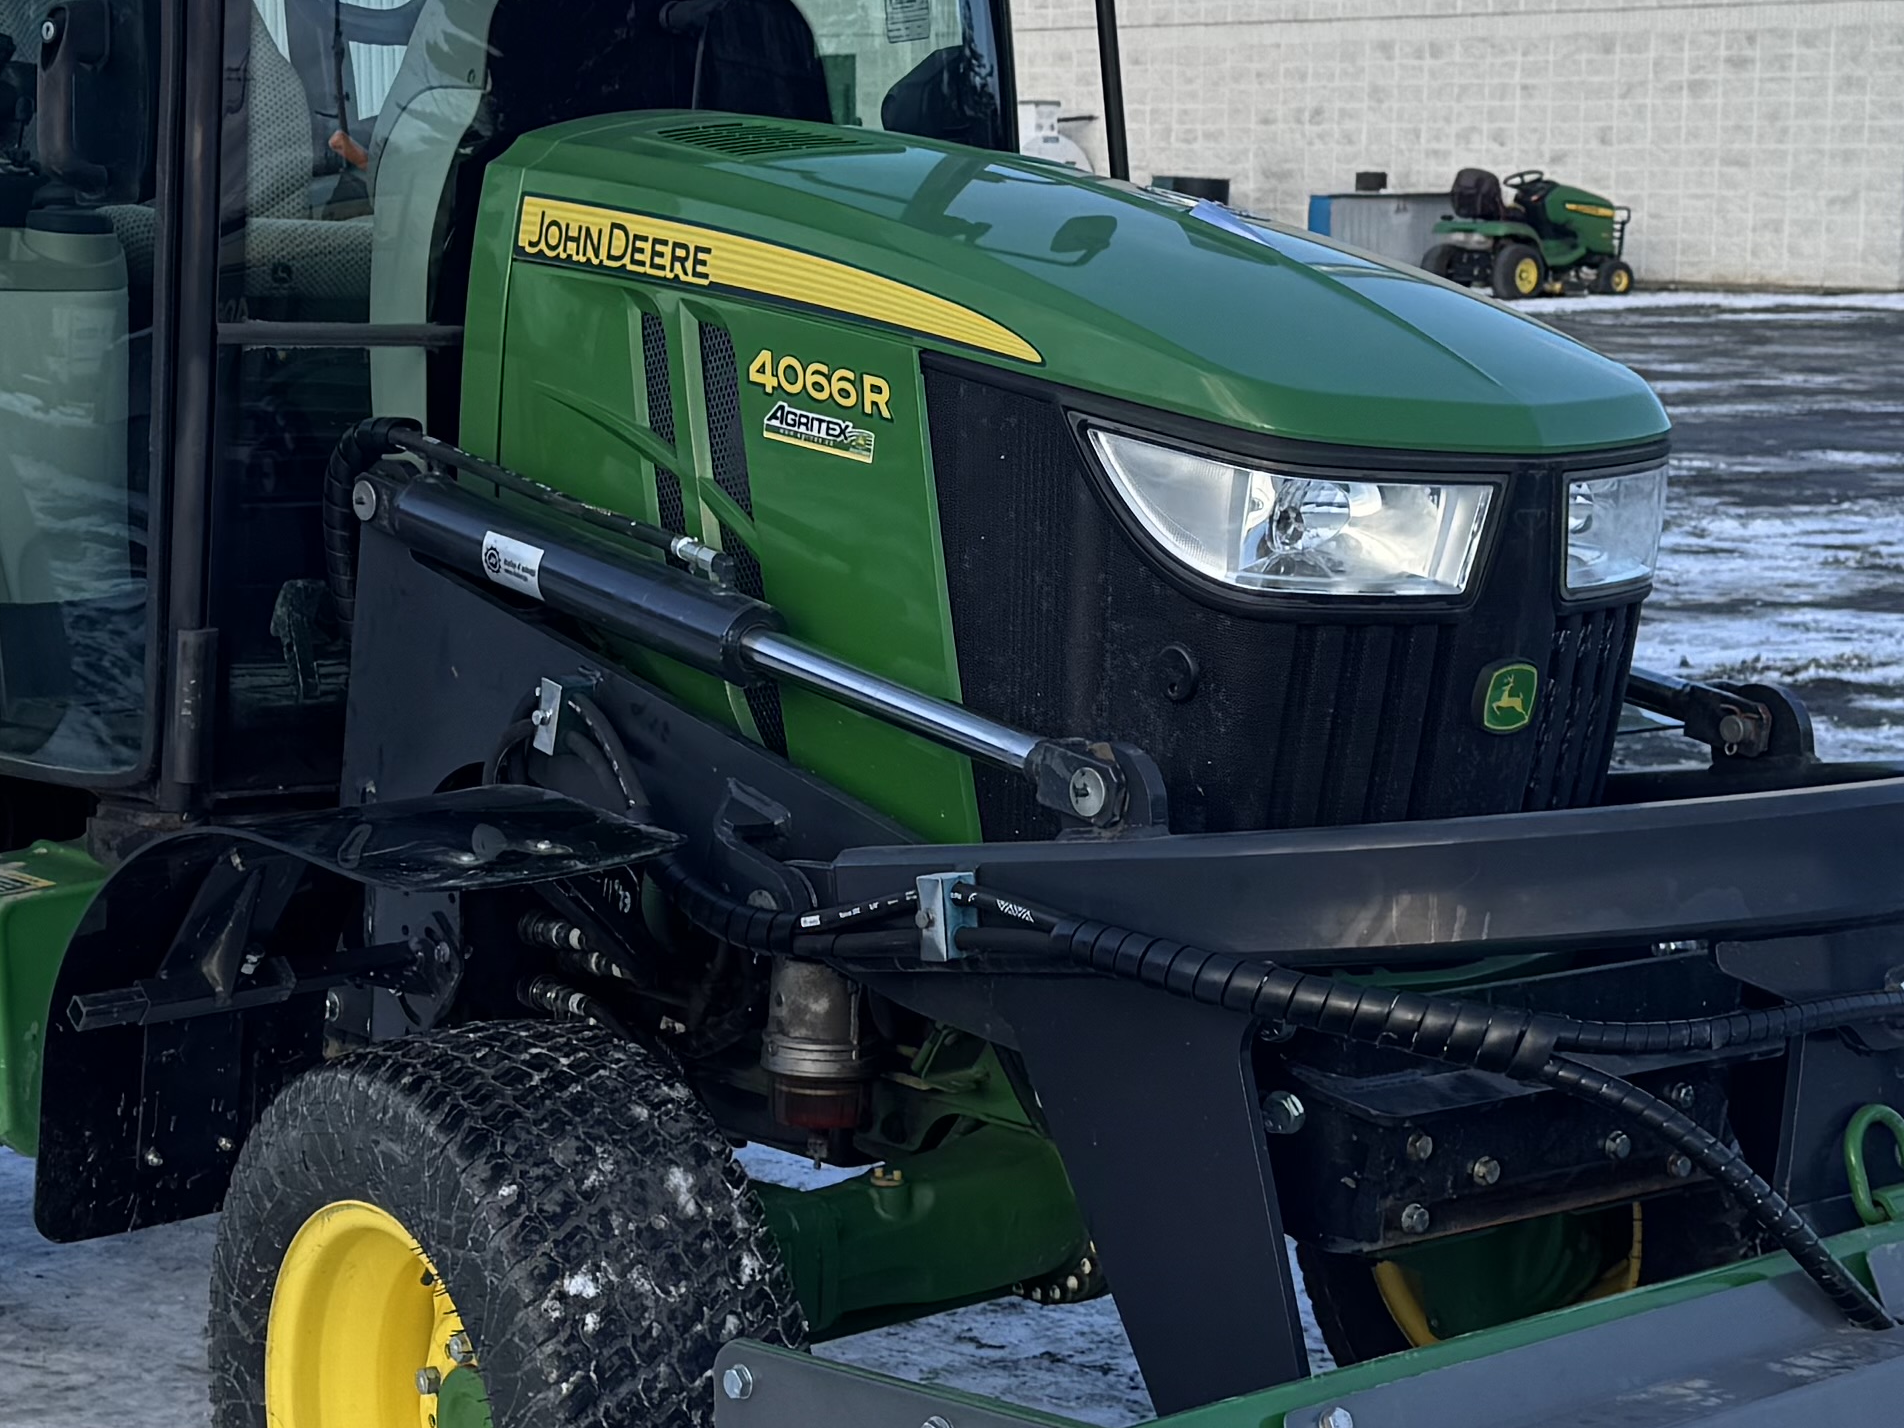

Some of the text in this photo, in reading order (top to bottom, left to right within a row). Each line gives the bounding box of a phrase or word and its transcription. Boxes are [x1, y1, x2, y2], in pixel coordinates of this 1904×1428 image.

[527, 210, 713, 281] JOHN DEERE
[767, 404, 850, 441] AGRITEX
